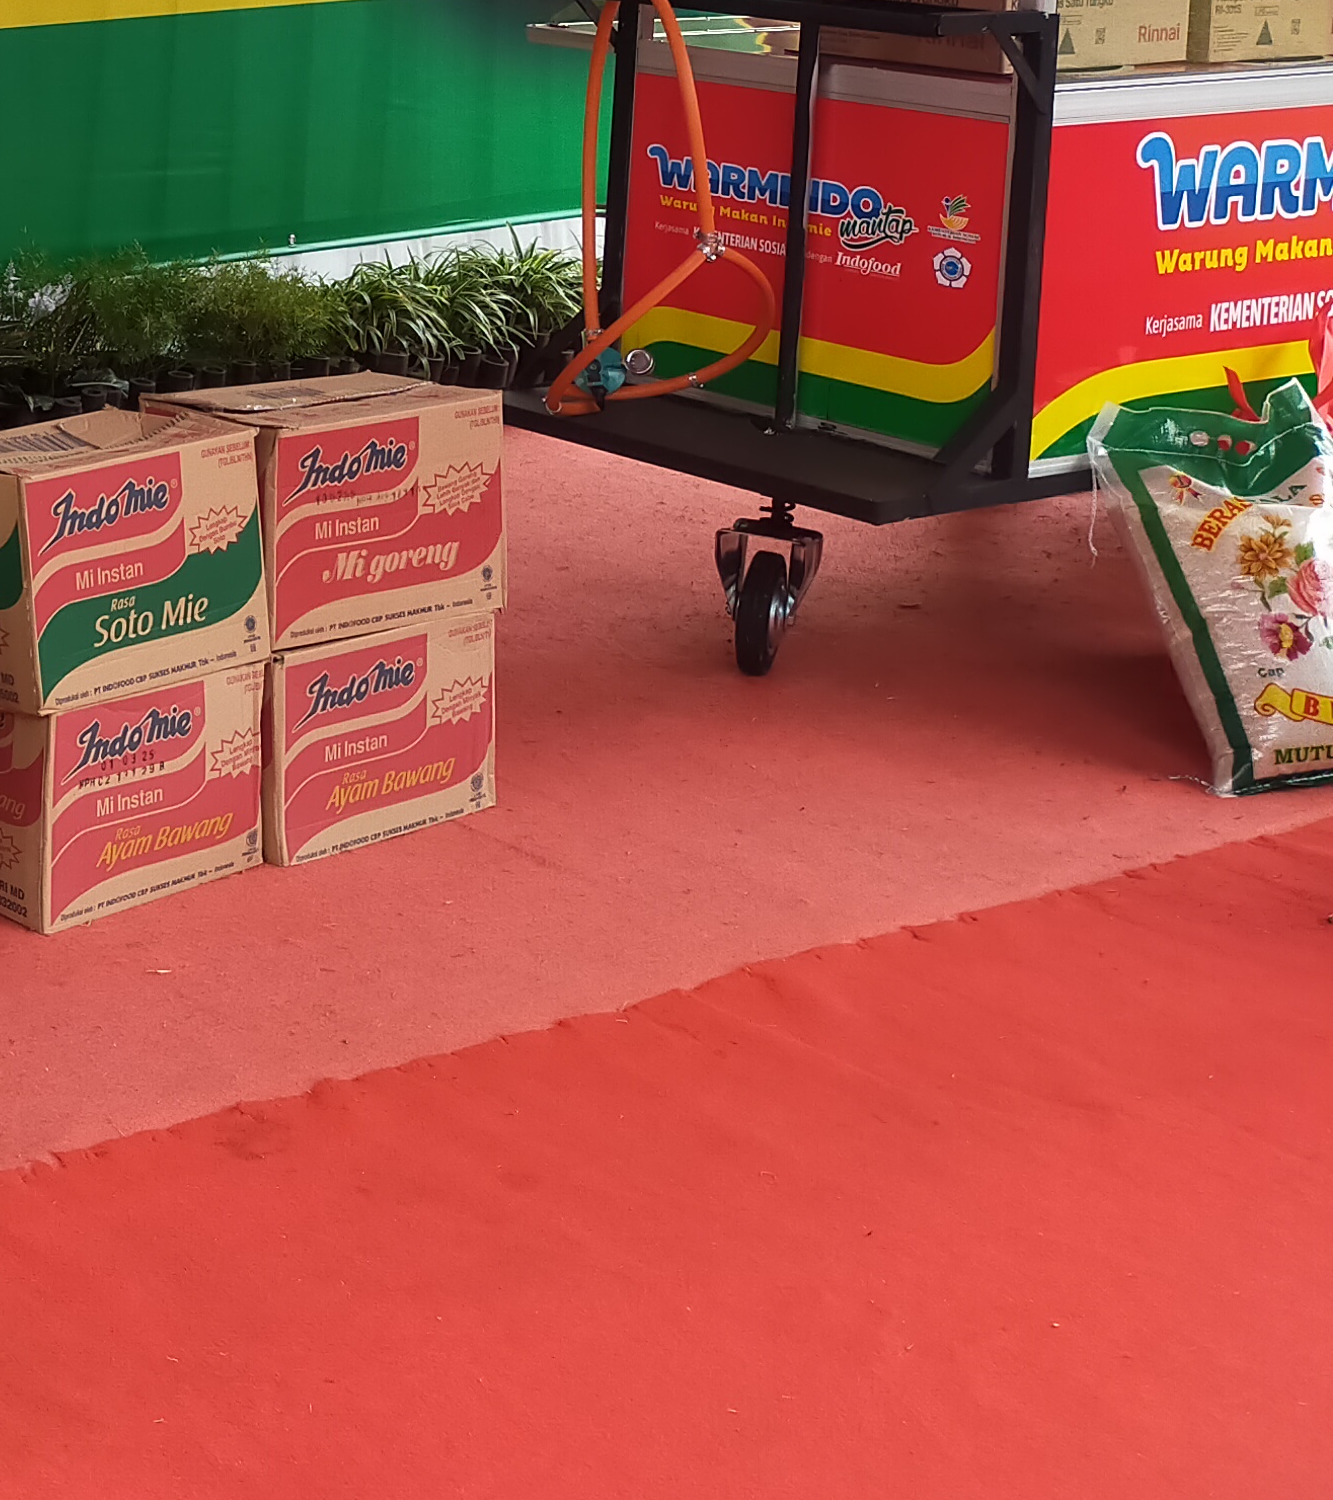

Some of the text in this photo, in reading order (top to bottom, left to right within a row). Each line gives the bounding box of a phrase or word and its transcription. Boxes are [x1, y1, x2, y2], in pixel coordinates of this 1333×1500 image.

[1137, 23, 1181, 44] Rinnai
[659, 194, 832, 237] Waru Makan Inmie
[838, 202, 920, 252] mantap
[654, 220, 690, 236] Kerjasama
[758, 239, 787, 256] SOSIA
[835, 250, 902, 276] Indofood
[1155, 235, 1333, 275] Warung Makan
[1145, 313, 1203, 338] Kerjasama
[1209, 292, 1316, 333] KEMENTERIAN
[315, 514, 380, 541] Mi Instan
[75, 561, 145, 592] Mi Instan
[322, 540, 461, 584] Mi goreng
[110, 596, 136, 613] Rasa
[93, 593, 209, 649] Soto Mie
[1258, 667, 1285, 678] Cap
[93, 686, 102, 696] PT
[324, 734, 388, 763] Mi Instan
[325, 756, 457, 815] Ayam Bawang
[341, 769, 367, 785] Rasa
[96, 786, 164, 818] Mi Instan
[96, 812, 234, 873] Ayam Bawang
[115, 824, 141, 843] Rasa
[10, 882, 25, 901] MD
